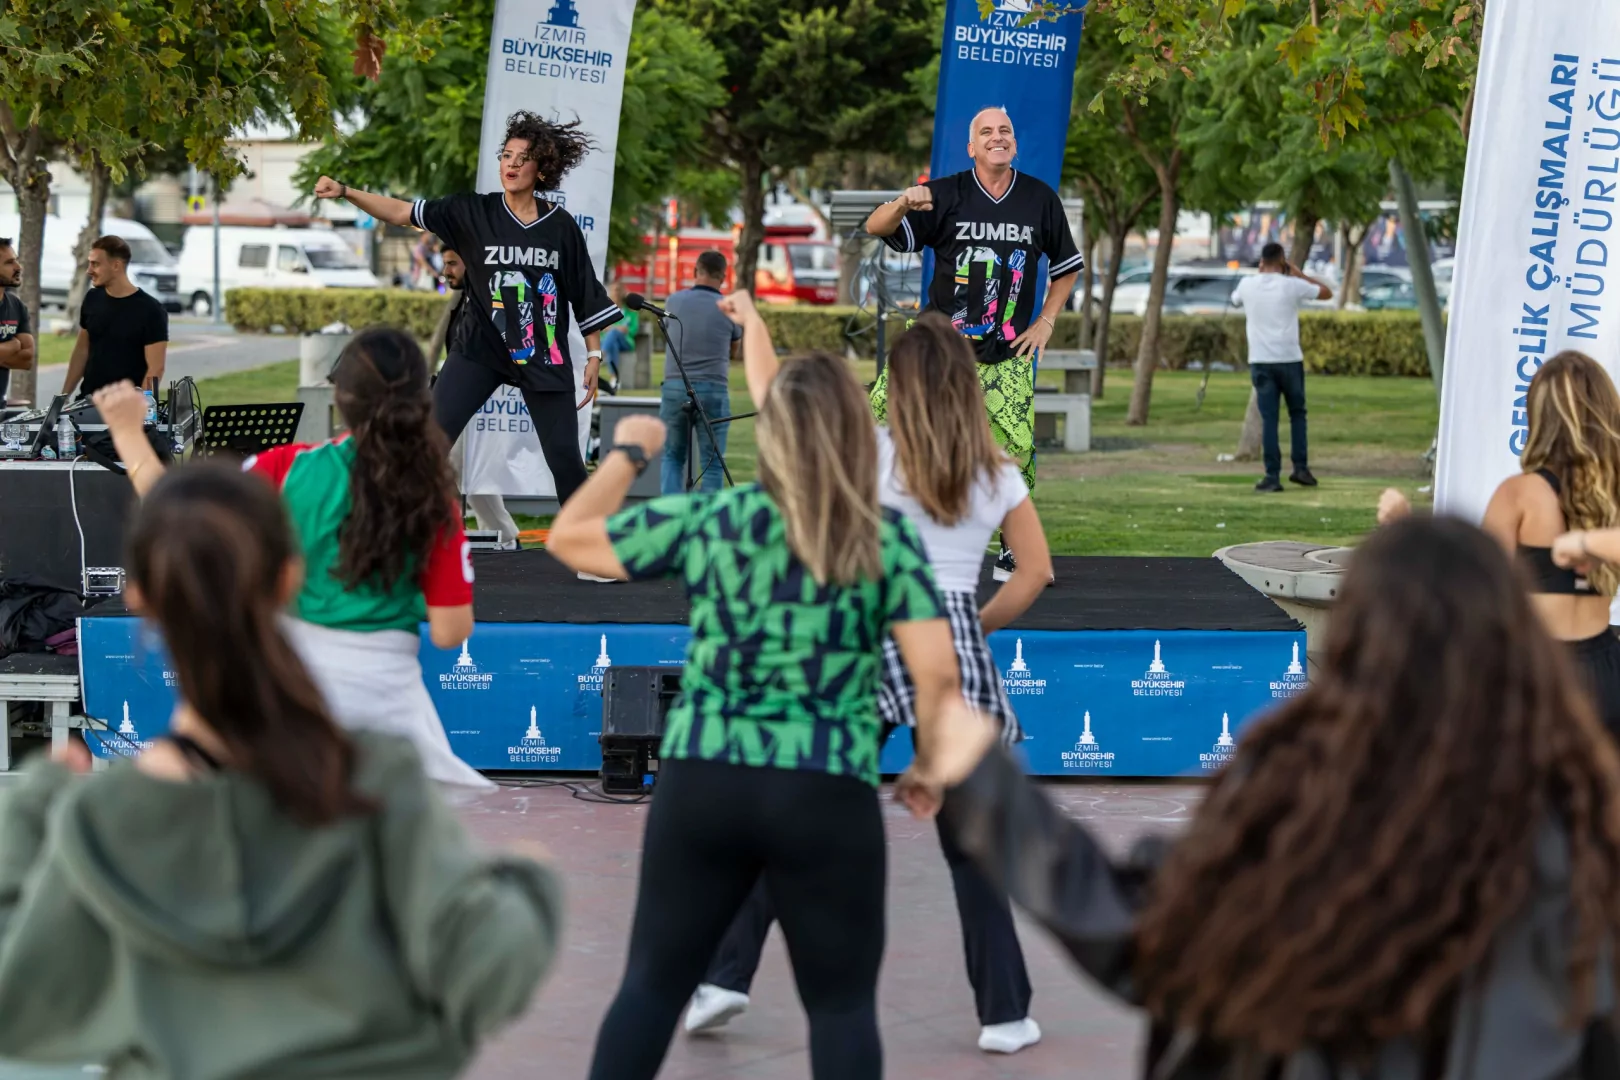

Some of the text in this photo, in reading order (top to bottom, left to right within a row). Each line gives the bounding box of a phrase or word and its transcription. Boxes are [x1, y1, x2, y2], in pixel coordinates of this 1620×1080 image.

[954, 24, 1067, 51] BÜYÜKŞEHİR
[502, 38, 613, 68] BÜYÜKŞEHİR
[957, 45, 1059, 68] BELEDİYESİ
[505, 58, 606, 84] BELEDİYESİ
[1526, 53, 1579, 292] ÇALIŞMALARI
[1566, 58, 1620, 340] MÜDÜRLÜĞÜ
[484, 245, 559, 270] ZUMBA
[1002, 678, 1047, 687] YÜKŞEHİR
[1006, 686, 1044, 695] LEDİYESİ
